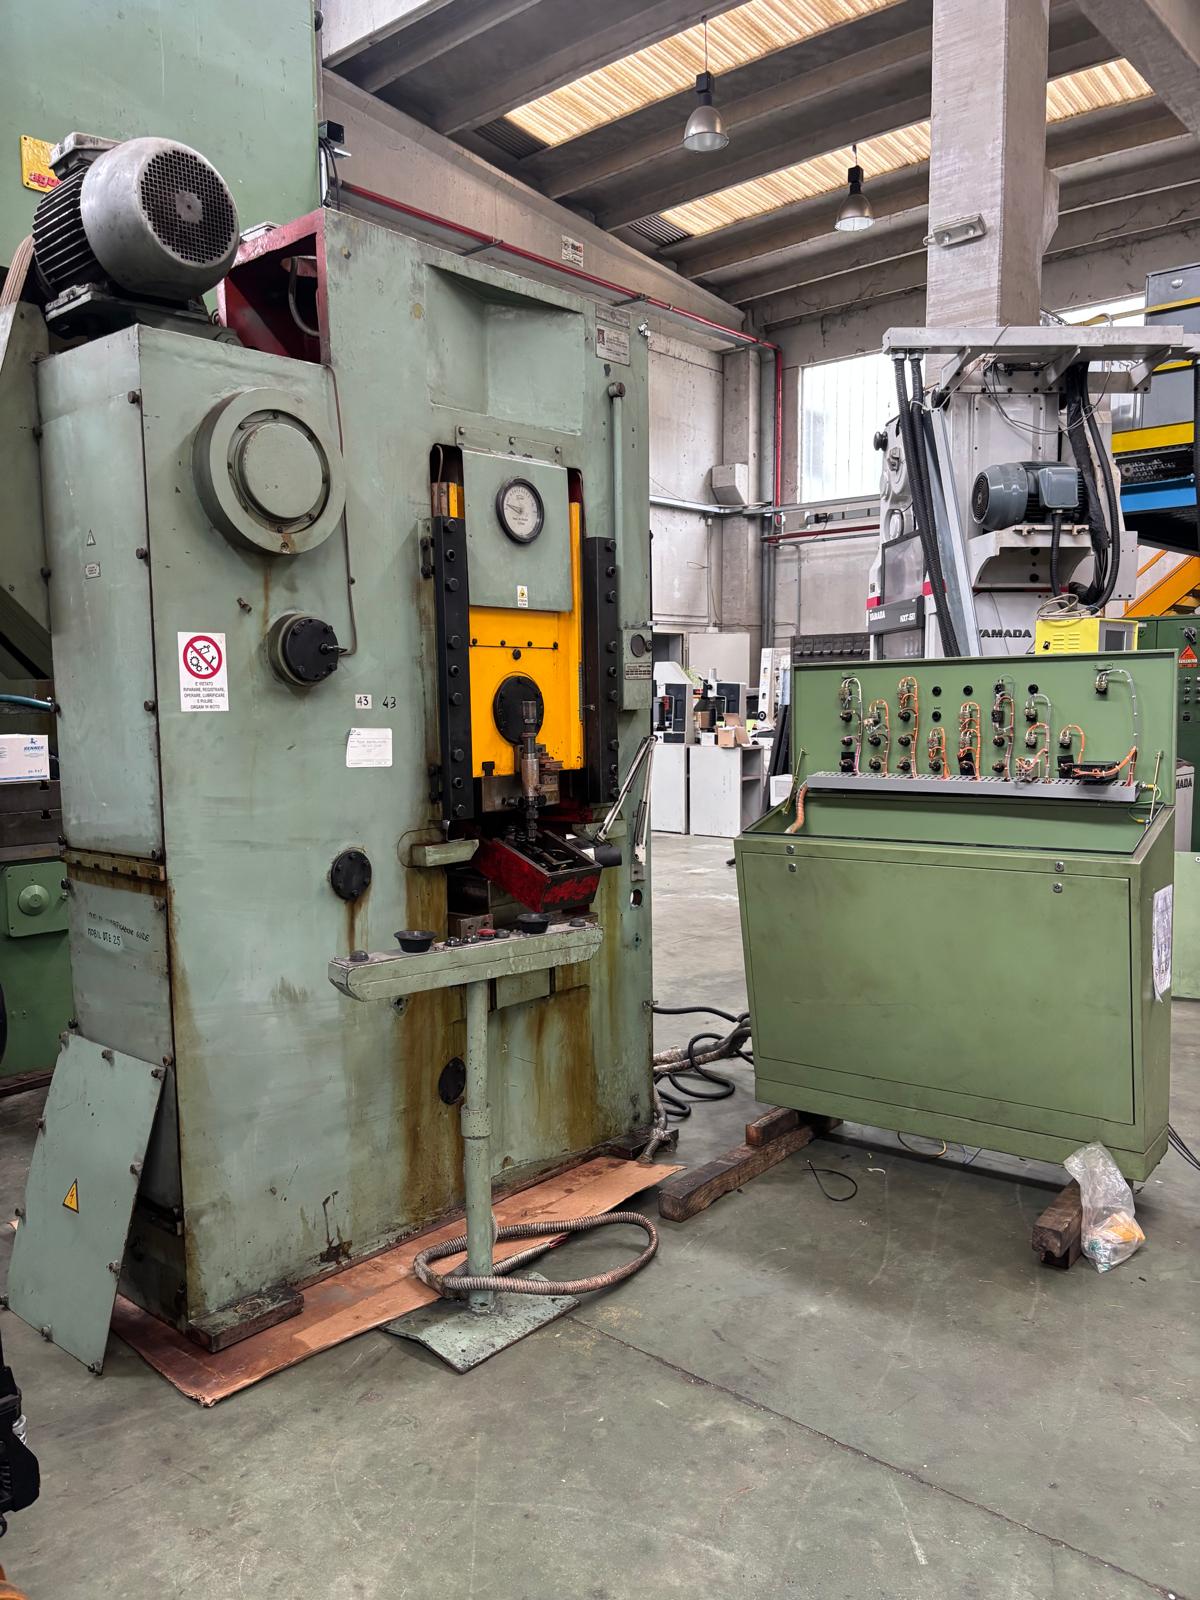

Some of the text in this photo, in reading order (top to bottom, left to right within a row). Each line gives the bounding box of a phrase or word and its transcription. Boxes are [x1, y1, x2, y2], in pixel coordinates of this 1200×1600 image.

[357, 695, 369, 706] 43
[382, 696, 397, 709] 43
[87, 927, 102, 939] MOBIL
[112, 934, 121, 946] 25
